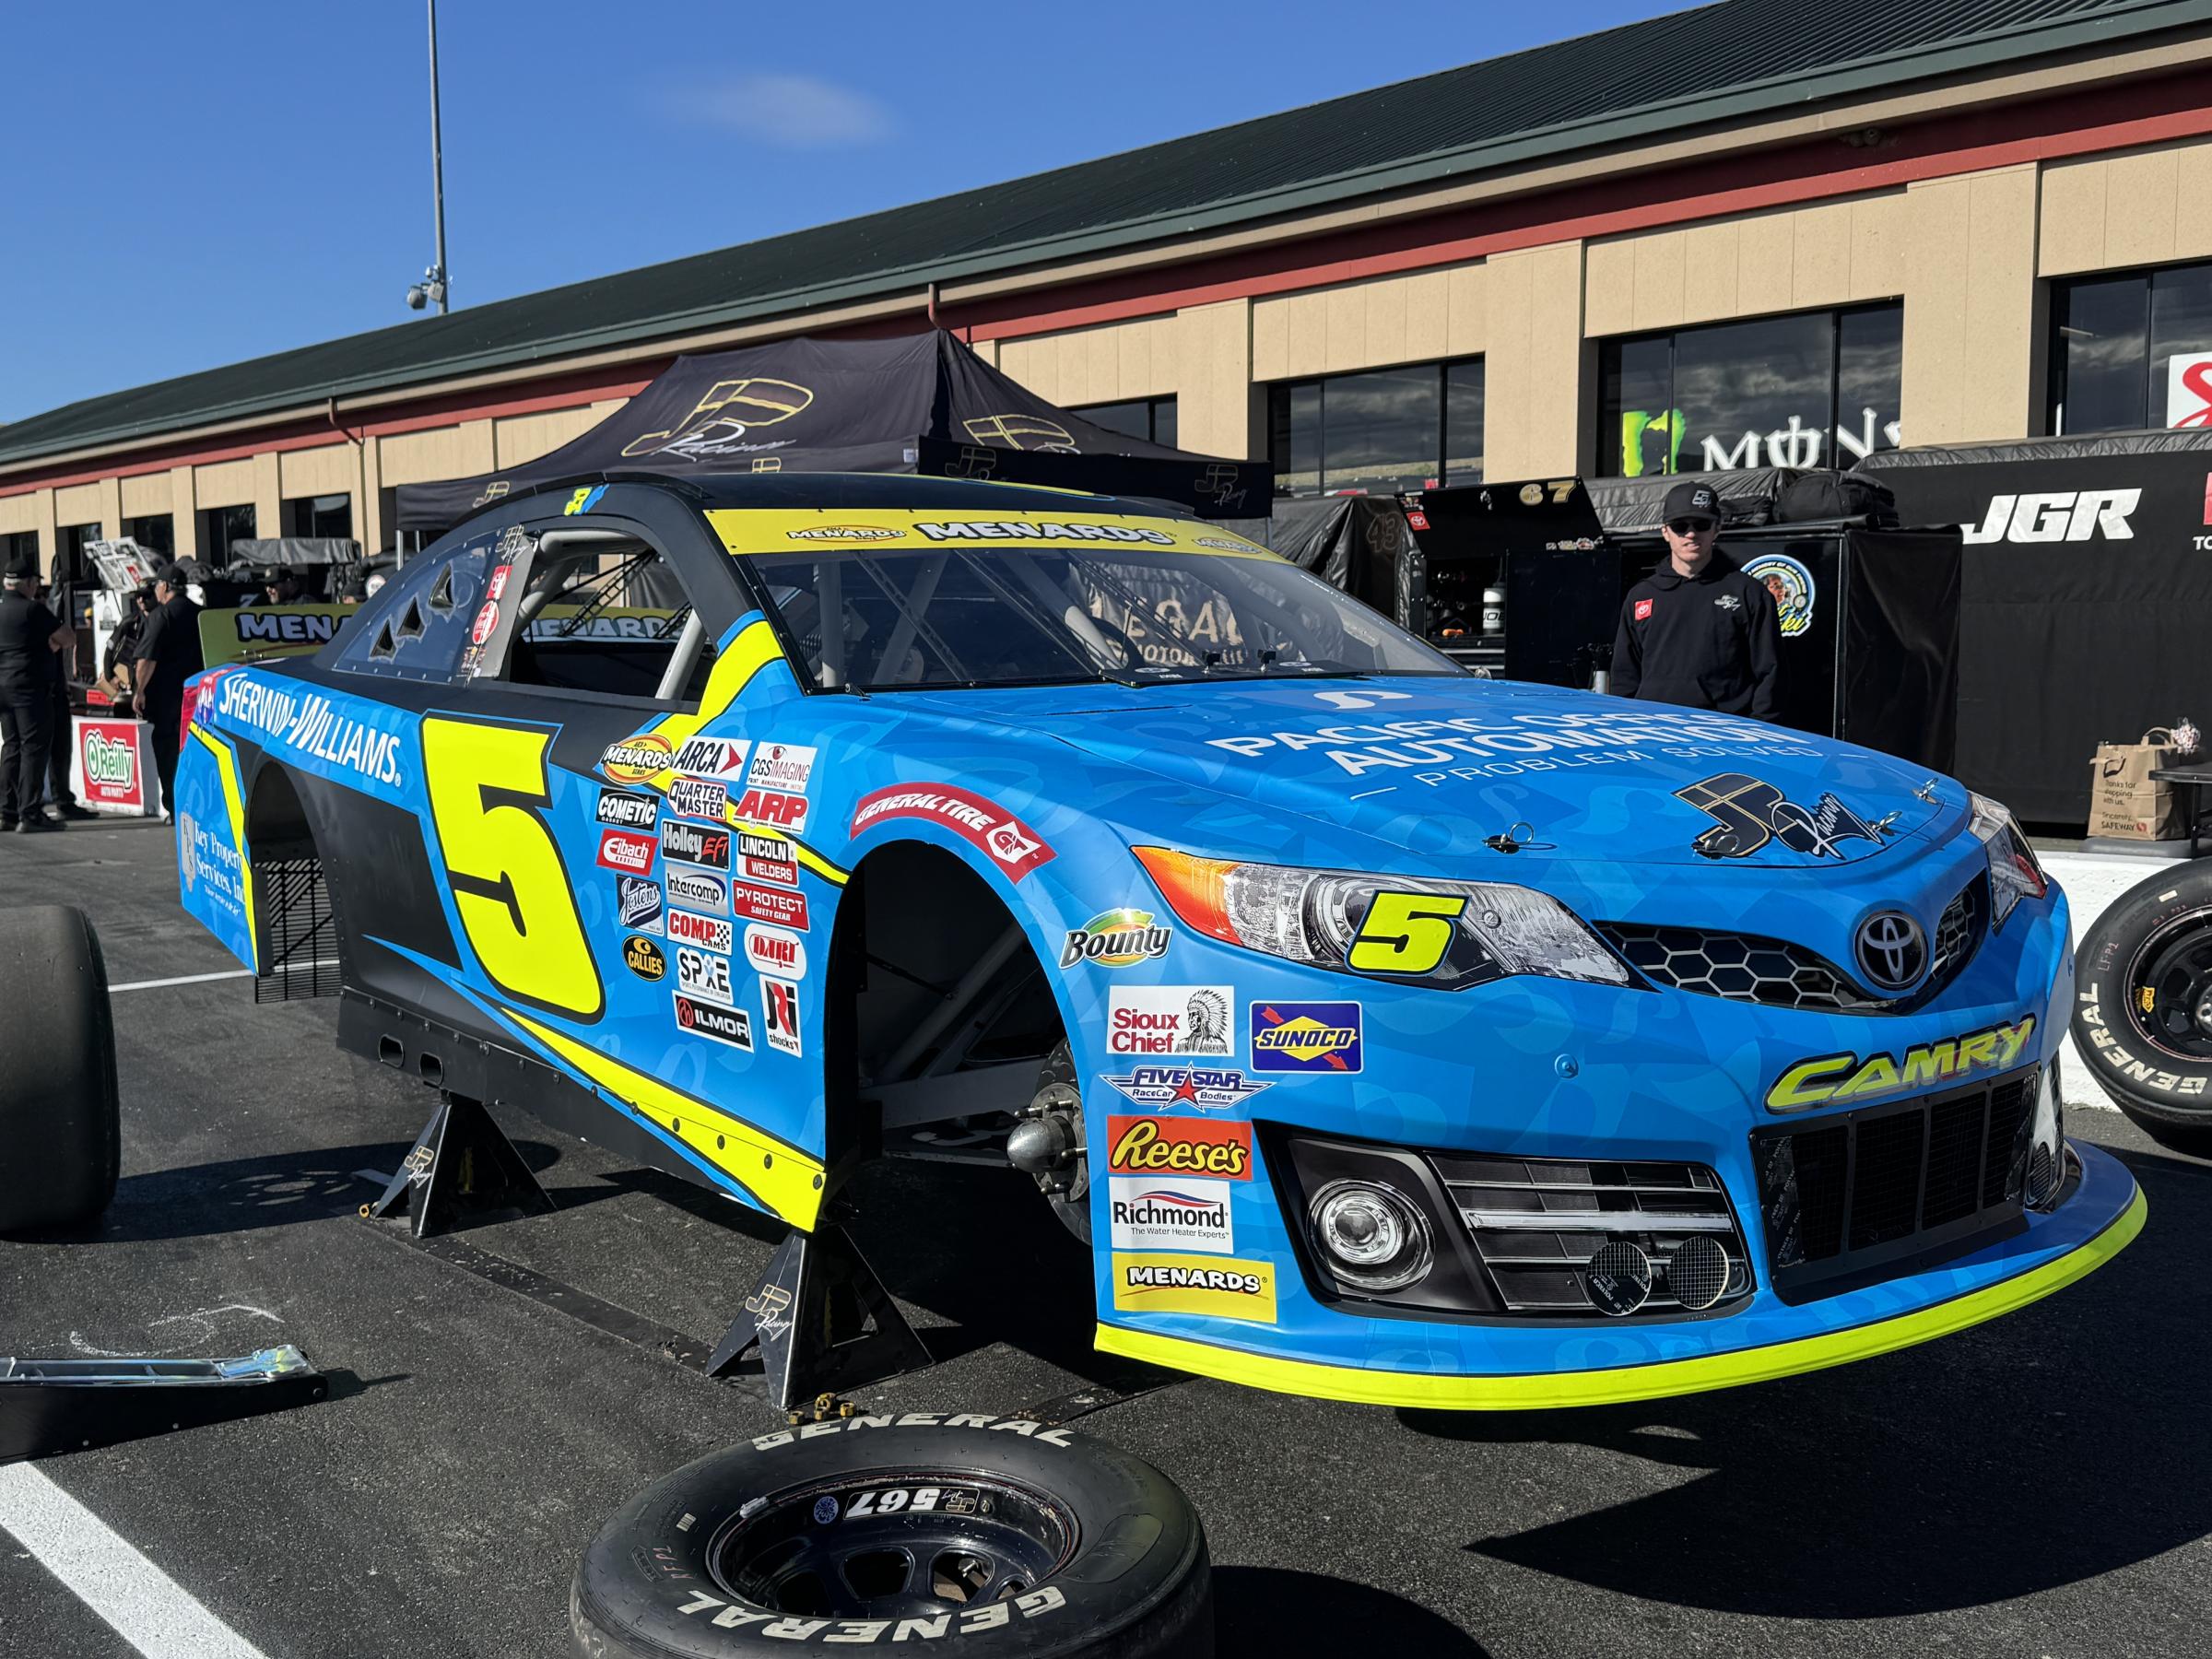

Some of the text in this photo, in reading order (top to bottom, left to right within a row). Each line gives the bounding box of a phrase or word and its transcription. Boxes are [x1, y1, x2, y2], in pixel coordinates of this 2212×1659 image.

[1959, 488, 2142, 546] JGR
[914, 522, 1176, 545] MENARDS
[219, 673, 401, 783] SHERWIN-WILLIAMS
[1204, 718, 1521, 757] PACIFIC
[86, 735, 133, 788] O'Reilly
[601, 745, 672, 771] MENARDS
[674, 740, 724, 774] ARCA
[1324, 725, 1810, 776] AUTOMATION
[1413, 746, 1823, 787] PROBLEM SOLVED
[669, 781, 724, 803] QUARTER
[598, 795, 657, 825] COMETIC
[677, 797, 724, 818] MASTER
[735, 790, 808, 825] ARP
[854, 793, 996, 831] GENERAL TIRE
[2101, 820, 2135, 831] SAFEWAY
[604, 837, 650, 862] Eibach
[663, 822, 703, 863] Holley
[740, 837, 788, 861] LINCOLN
[420, 716, 603, 1013] 5
[751, 859, 793, 882] WELDERS
[667, 873, 721, 906] Intercomp
[736, 888, 804, 913] PYROTECT
[669, 912, 716, 941] COMP
[751, 905, 792, 922] SAFETY GEAR
[701, 937, 726, 951] CAMS
[1061, 925, 1172, 968] Bounty
[1348, 891, 1470, 973] 5
[628, 950, 663, 976] CALLIES
[695, 1009, 749, 1039] ILMOR
[1112, 1007, 1180, 1030] Sioux
[769, 1033, 794, 1051] shocks
[1112, 1031, 1174, 1053] Chief
[1259, 1029, 1355, 1049] SUNOCO
[2079, 982, 2207, 1095] GENERAL
[1134, 1068, 1243, 1089] FIVE STAR
[1765, 1016, 2035, 1112] CAMRY
[1133, 1088, 1234, 1101] RaceCar Bodies
[1112, 1121, 1247, 1174] Reese's
[1113, 1200, 1226, 1229] Richmond
[1131, 1227, 1226, 1240] The Water Heater Experts
[1126, 1266, 1261, 1294] MENARDS
[751, 1412, 1076, 1452] GENERAL
[847, 1488, 941, 1519] 567
[677, 1585, 1067, 1644] GENERAL
